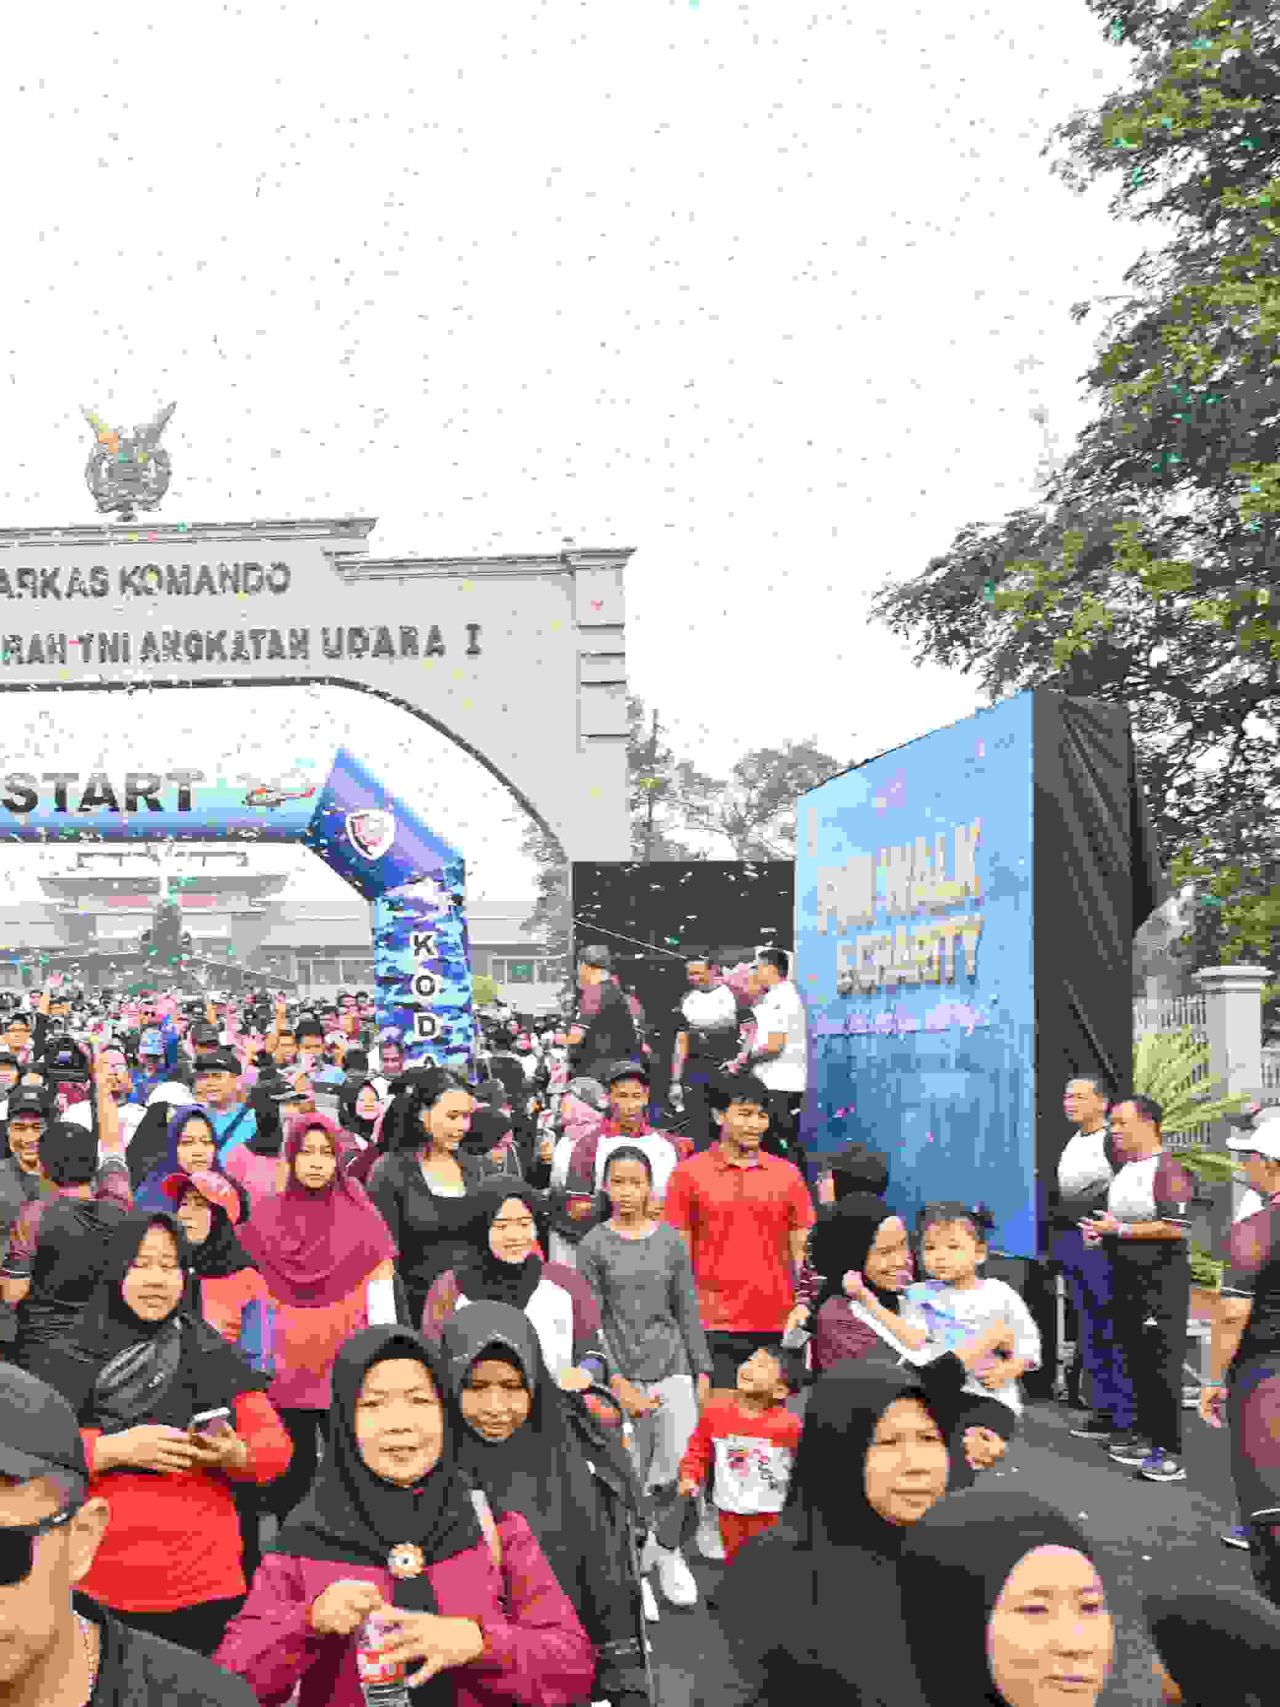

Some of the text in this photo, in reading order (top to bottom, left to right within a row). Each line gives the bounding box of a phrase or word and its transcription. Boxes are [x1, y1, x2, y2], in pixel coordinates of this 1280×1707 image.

[119, 562, 291, 597] KOMANDO
[77, 631, 130, 664] TNI
[139, 627, 310, 664] ANGKATAN
[321, 624, 447, 660] UDARA
[465, 623, 482, 656] I
[1, 772, 205, 814] START
